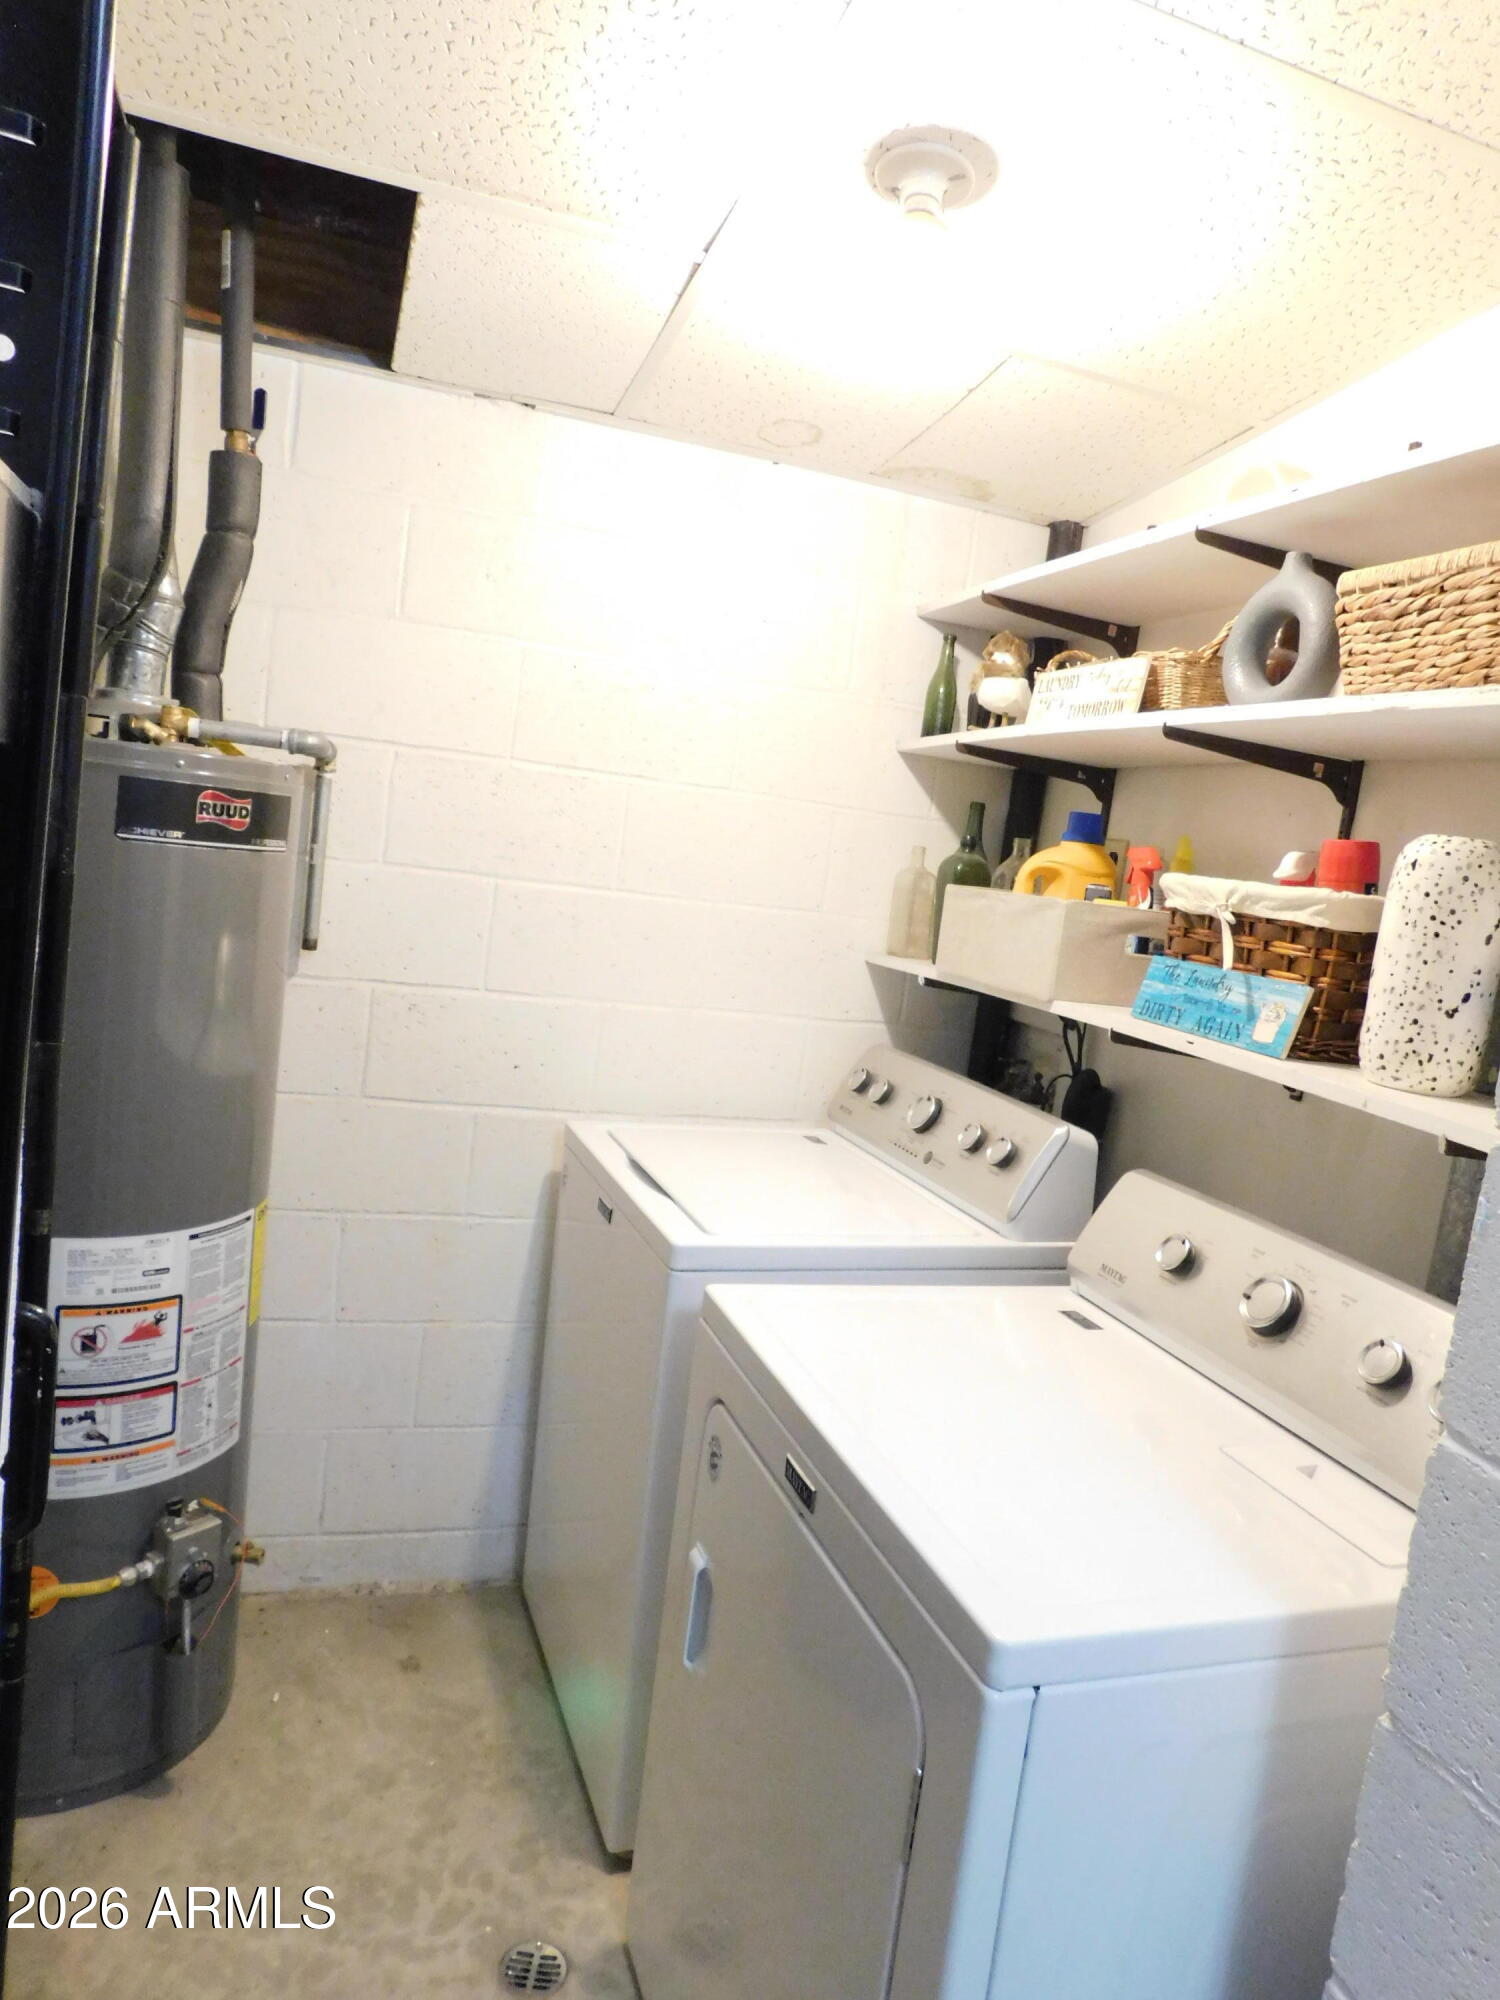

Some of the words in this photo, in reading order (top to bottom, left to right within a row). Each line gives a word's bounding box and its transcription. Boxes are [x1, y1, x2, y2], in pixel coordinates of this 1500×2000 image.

[198, 801, 250, 819] RUUD
[1164, 963, 1181, 982] The
[1184, 969, 1233, 1000] Laundry
[1139, 999, 1187, 1025] DIRTY
[1191, 1015, 1246, 1042] AGAIN
